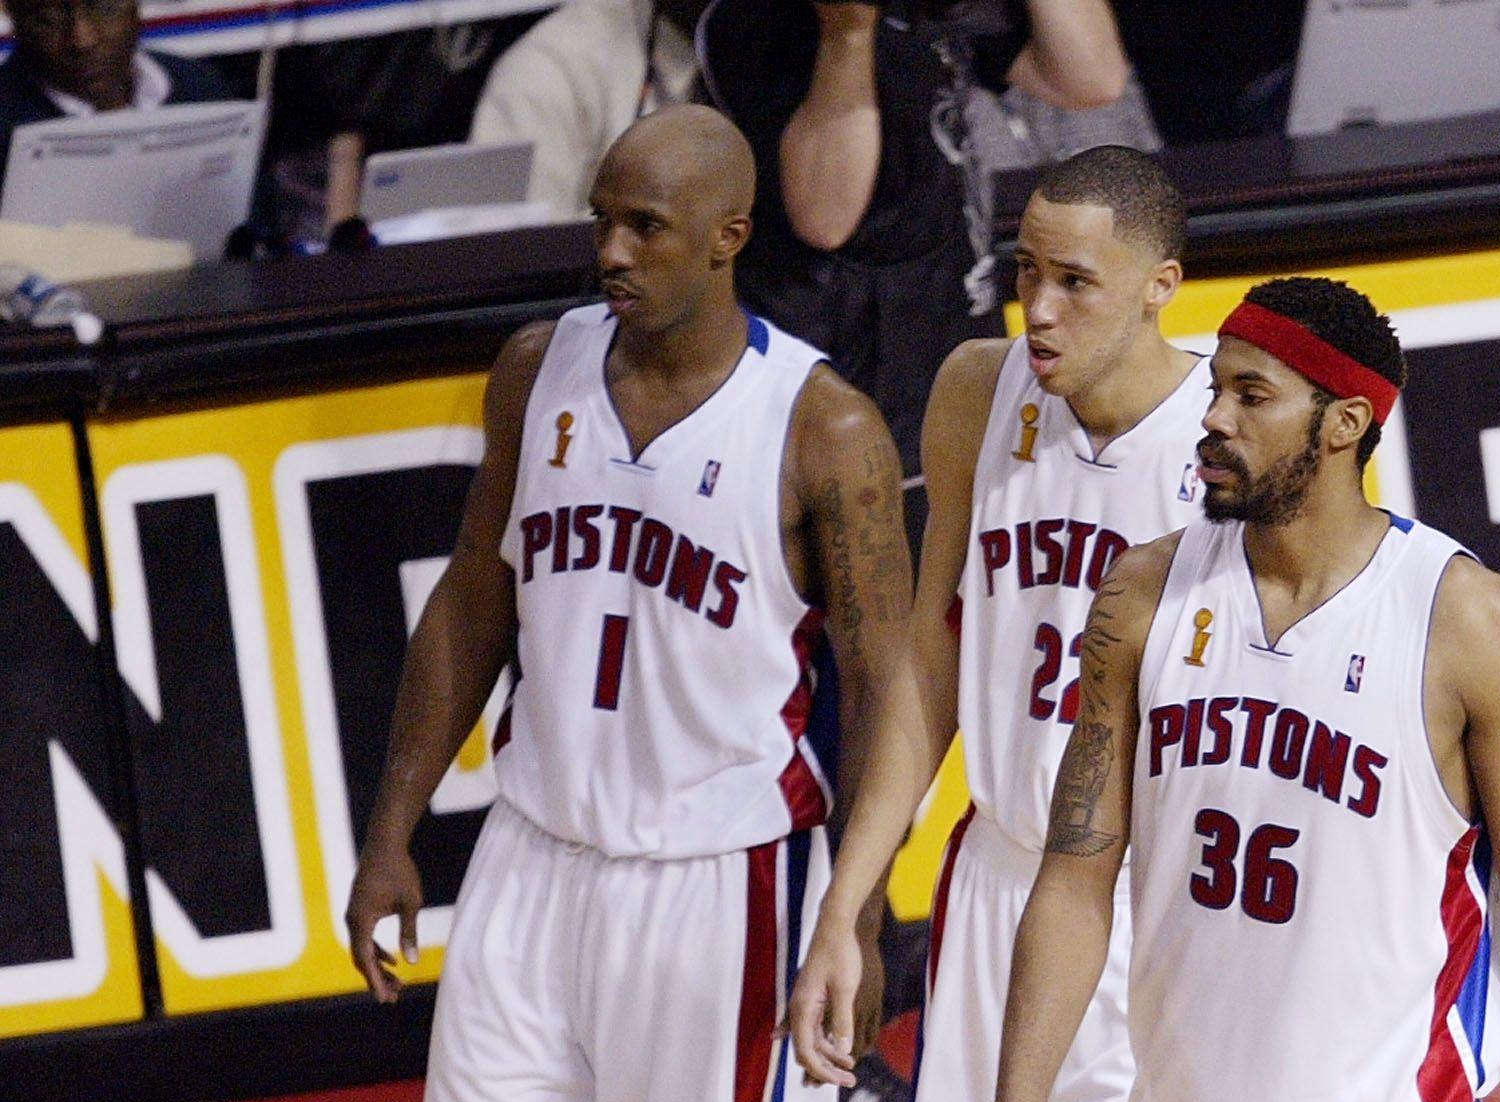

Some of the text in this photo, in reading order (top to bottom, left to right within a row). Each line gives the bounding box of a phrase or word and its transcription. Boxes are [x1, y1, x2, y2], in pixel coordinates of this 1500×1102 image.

[519, 503, 748, 630] PISTONS
[979, 518, 1130, 598] PISTO
[592, 613, 631, 711] 1
[1148, 696, 1388, 819] PISTONS
[1188, 808, 1300, 925] 36
